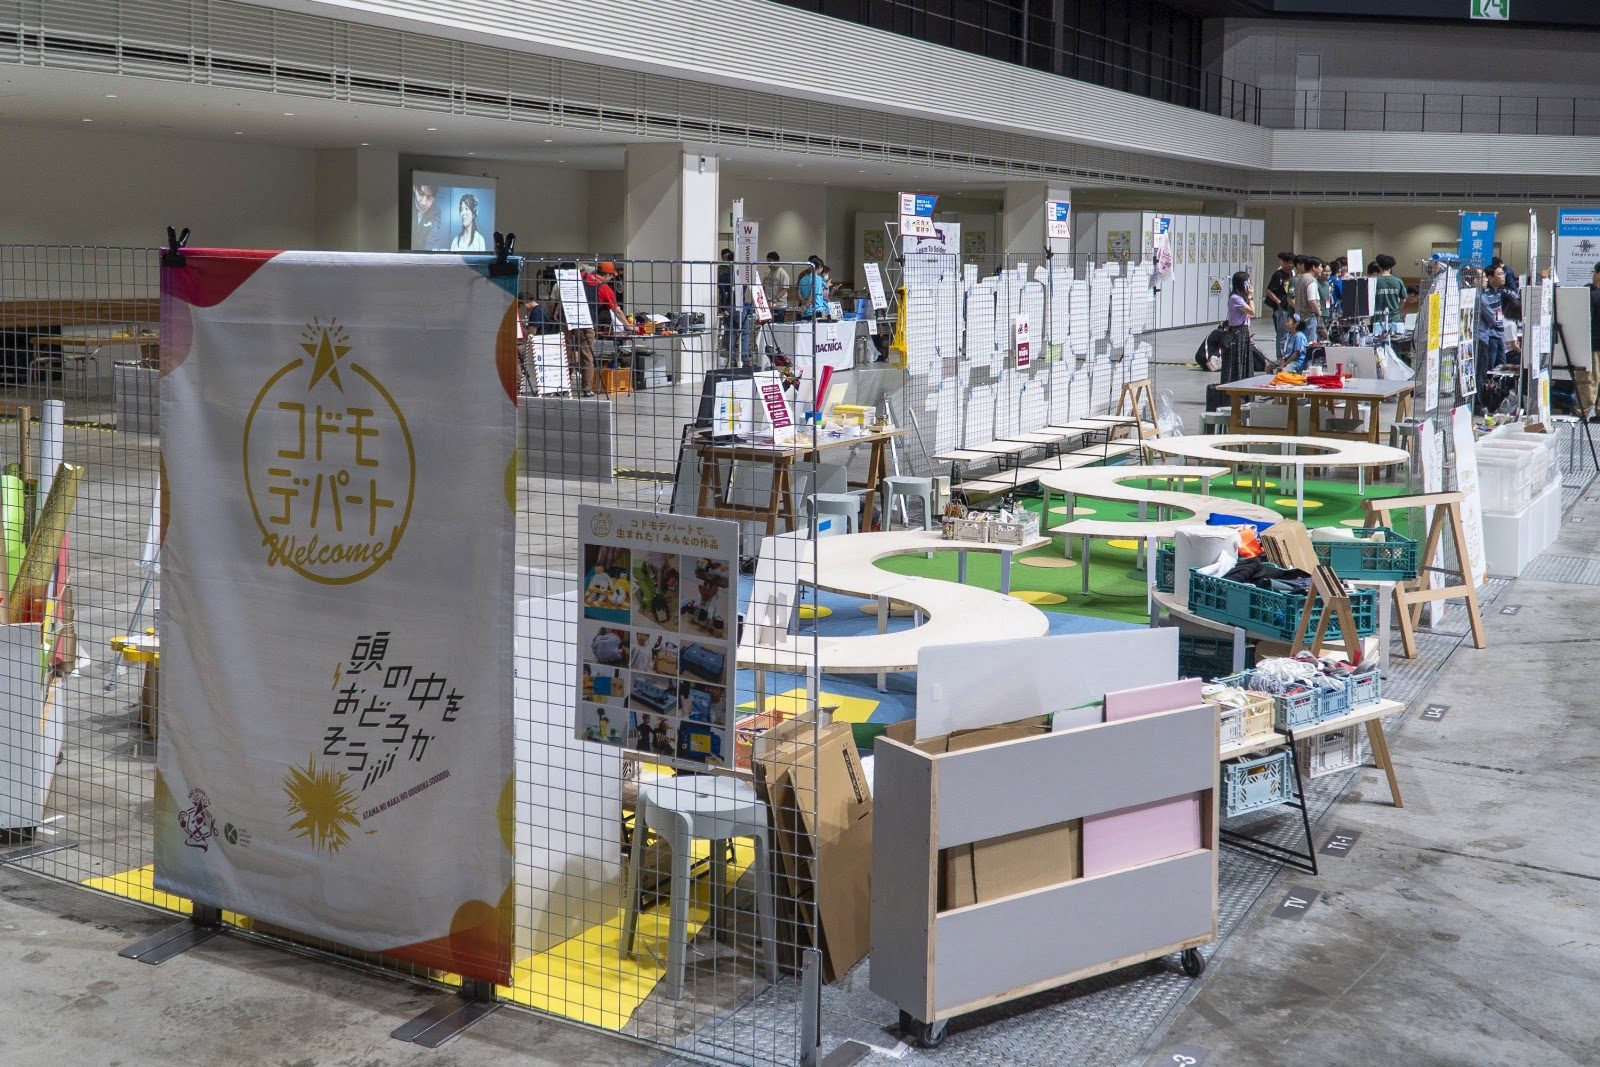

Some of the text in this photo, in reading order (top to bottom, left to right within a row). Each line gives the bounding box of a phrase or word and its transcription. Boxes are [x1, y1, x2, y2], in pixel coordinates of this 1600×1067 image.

[277, 401, 379, 468] コドモ
[267, 468, 395, 537] デパート
[346, 631, 465, 722] 頭の中を
[333, 682, 436, 762] おどろか
